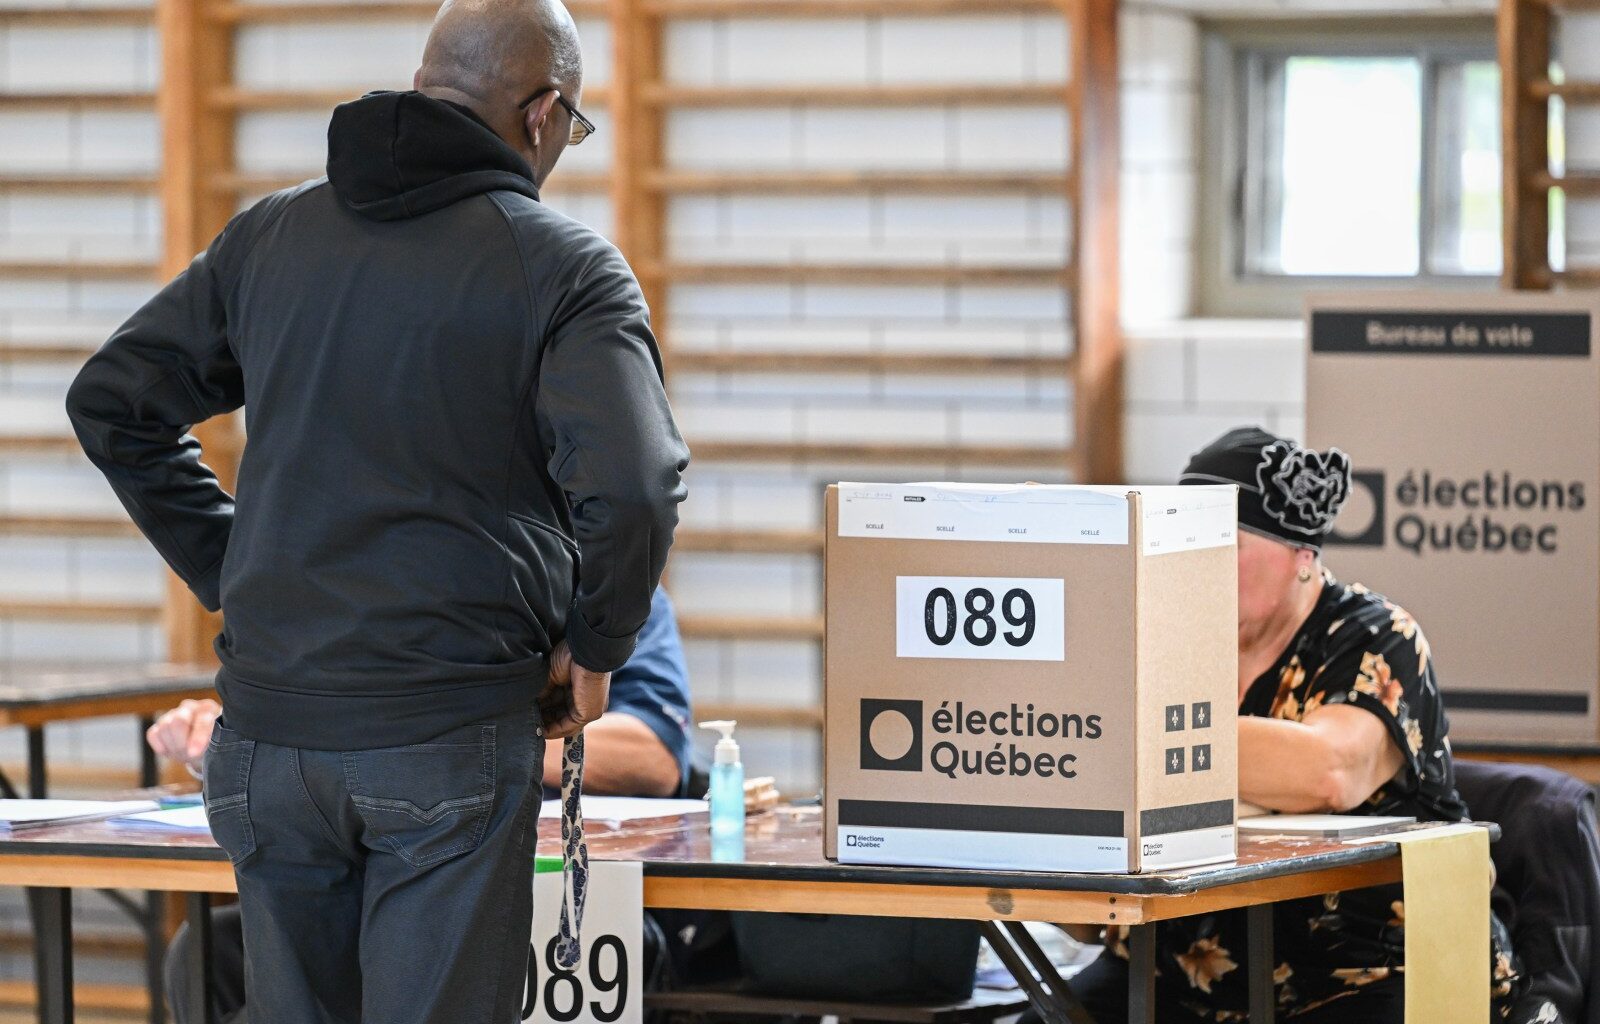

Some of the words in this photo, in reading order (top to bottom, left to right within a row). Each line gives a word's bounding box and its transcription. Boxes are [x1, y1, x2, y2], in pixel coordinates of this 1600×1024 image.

[1365, 320, 1446, 345] Bureau
[1451, 322, 1479, 345] de
[1486, 324, 1533, 346] vote
[1396, 470, 1586, 510] élections
[1394, 514, 1557, 556] Québec
[924, 587, 1036, 647] 089
[931, 701, 1103, 739] élections
[930, 741, 1078, 779] Québec
